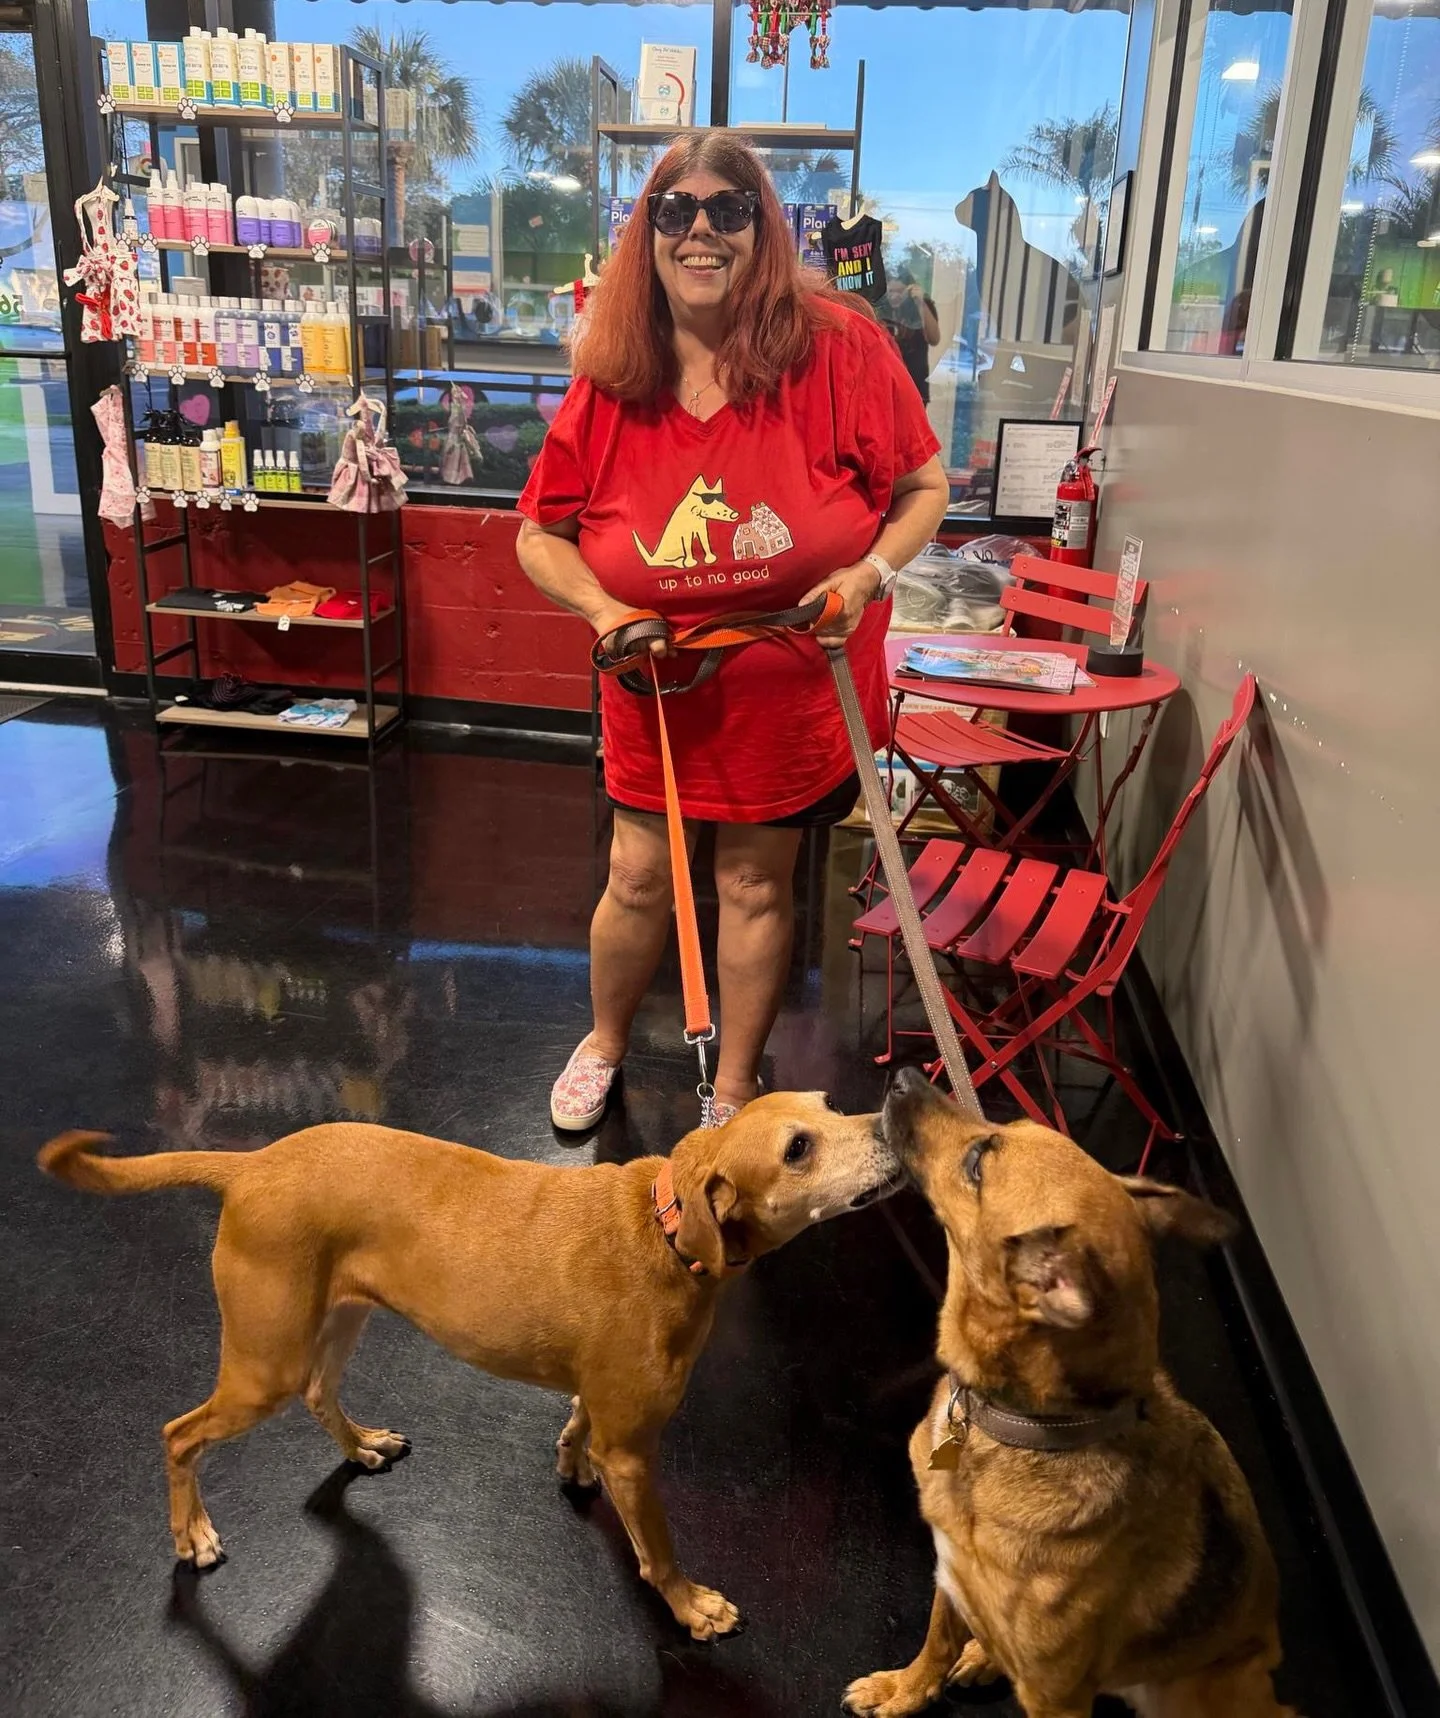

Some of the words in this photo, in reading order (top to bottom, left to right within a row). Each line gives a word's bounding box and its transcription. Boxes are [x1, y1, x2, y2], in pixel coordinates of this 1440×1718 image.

[834, 248, 848, 261] I'M
[852, 243, 872, 258] SEXY
[838, 260, 861, 276] AND
[866, 257, 871, 271] I
[837, 275, 861, 289] KNOW
[865, 271, 873, 285] IT
[659, 579, 678, 592] up
[684, 575, 703, 587] to
[707, 572, 726, 584] no
[732, 565, 769, 584] good
